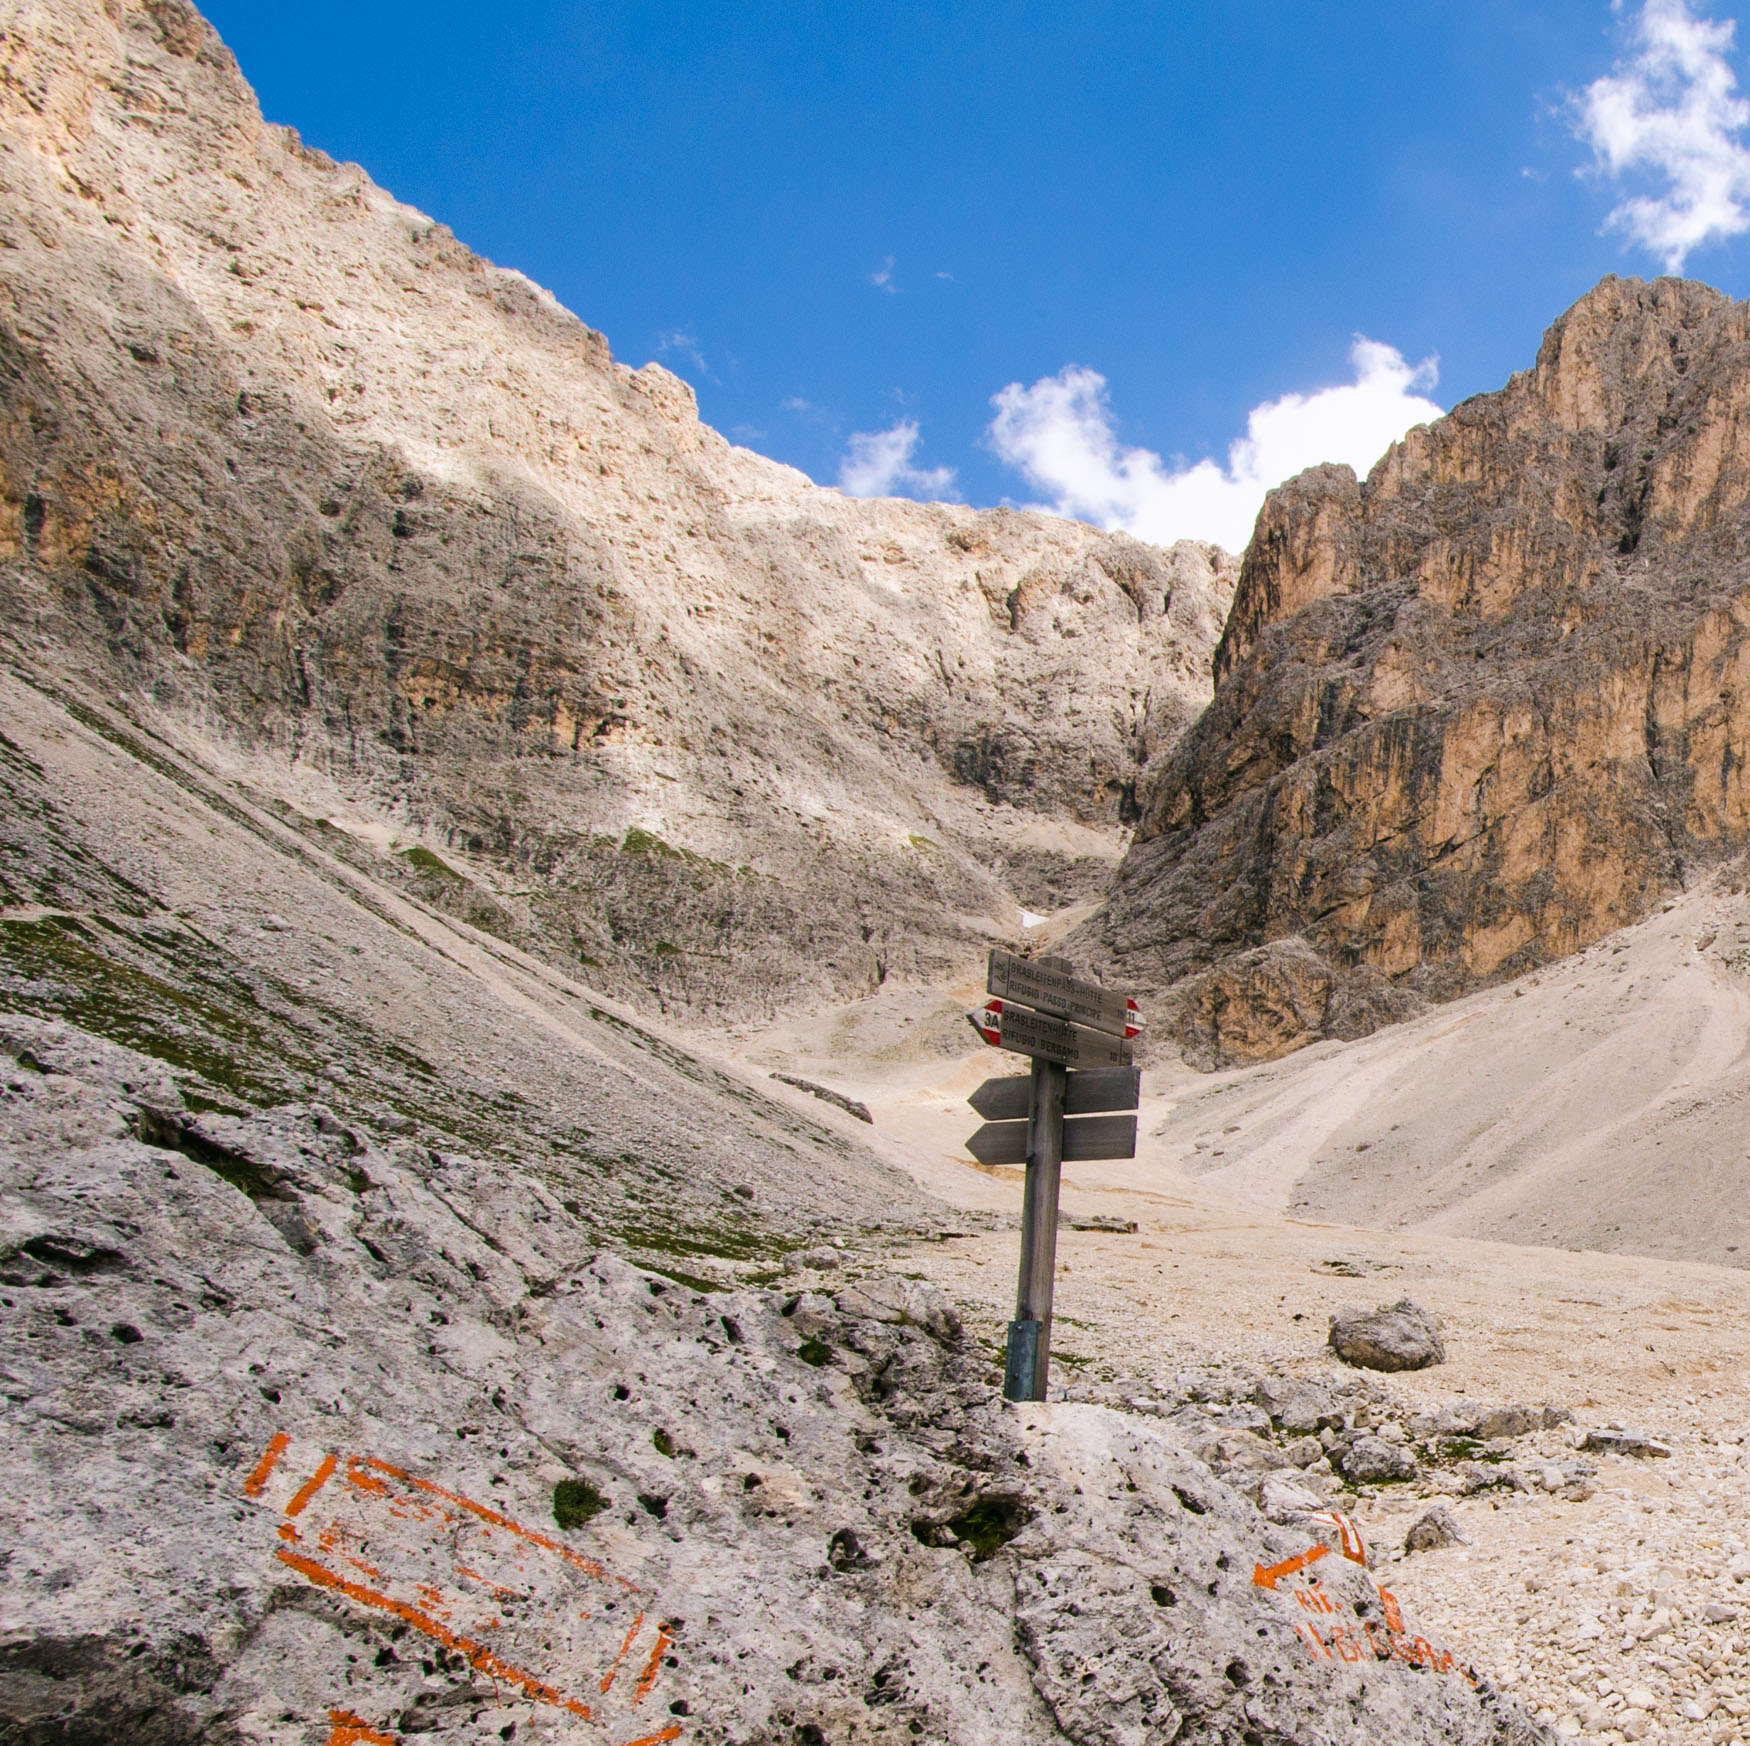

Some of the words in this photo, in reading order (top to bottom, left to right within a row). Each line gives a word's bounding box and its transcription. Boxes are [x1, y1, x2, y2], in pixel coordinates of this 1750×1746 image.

[1008, 980, 1039, 1000] RIFUGIO
[1043, 991, 1067, 1009] PASSO
[1070, 1001, 1103, 1021] PRINCIPE
[984, 1012, 999, 1029] 3A
[1127, 1011, 1135, 1024] 11
[1002, 1028, 1036, 1047] RIFUGIO
[1040, 1039, 1080, 1060] BERGAMO
